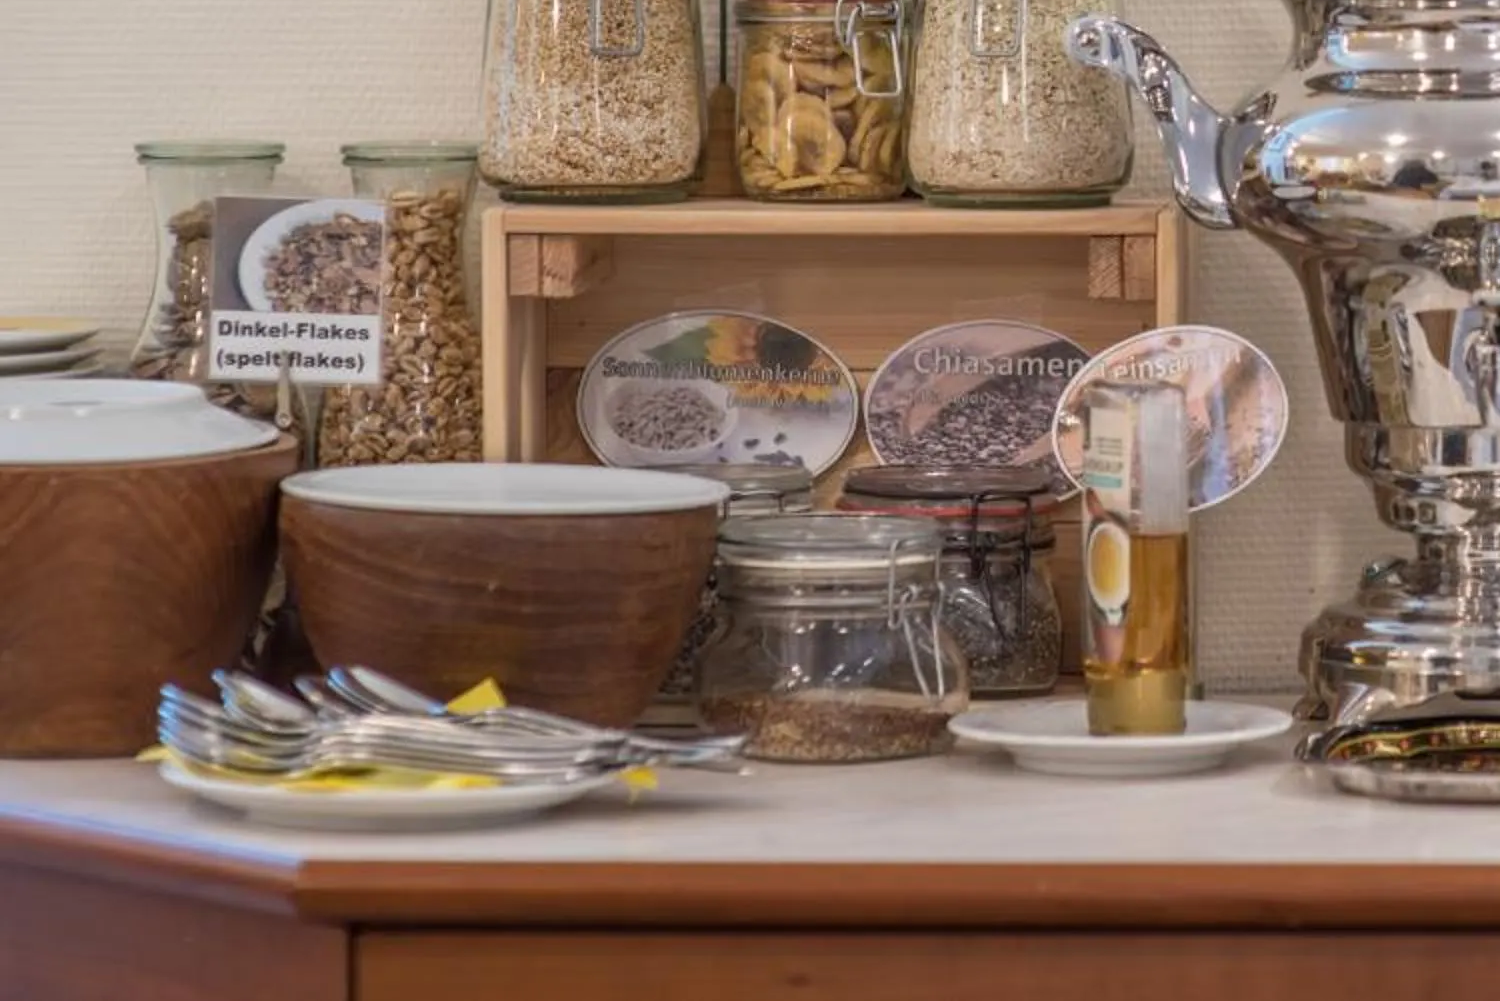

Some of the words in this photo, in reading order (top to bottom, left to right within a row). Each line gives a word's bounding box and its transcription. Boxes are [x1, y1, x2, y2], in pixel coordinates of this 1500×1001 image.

[217, 319, 370, 341] Dinkel-Flakes
[216, 349, 282, 370] (spelt
[286, 351, 366, 373] flakes)
[913, 346, 1085, 378] Chiasamen
